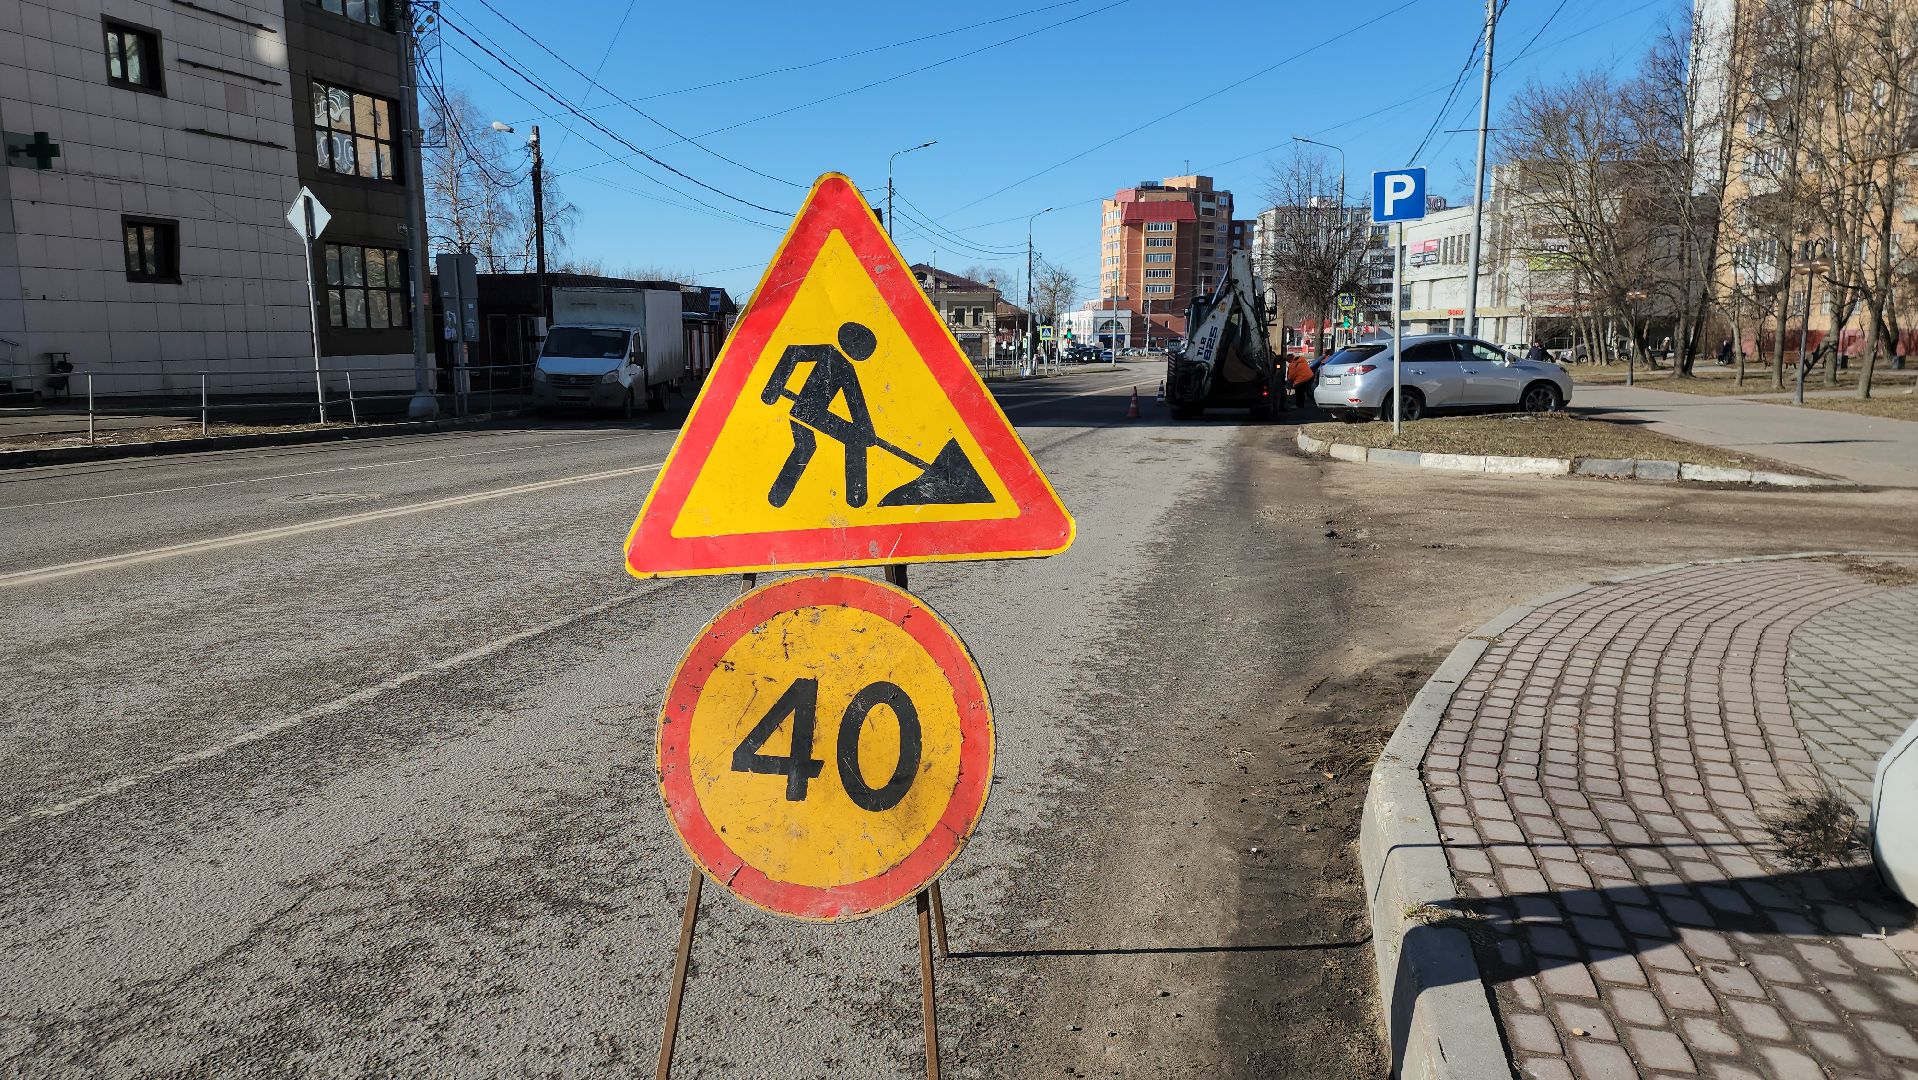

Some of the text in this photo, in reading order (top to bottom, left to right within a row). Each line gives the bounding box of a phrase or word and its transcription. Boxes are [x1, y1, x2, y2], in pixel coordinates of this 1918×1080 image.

[1384, 174, 1416, 216] P
[1197, 337, 1206, 356] TLB
[1204, 326, 1218, 360] 825
[731, 677, 922, 813] 40
